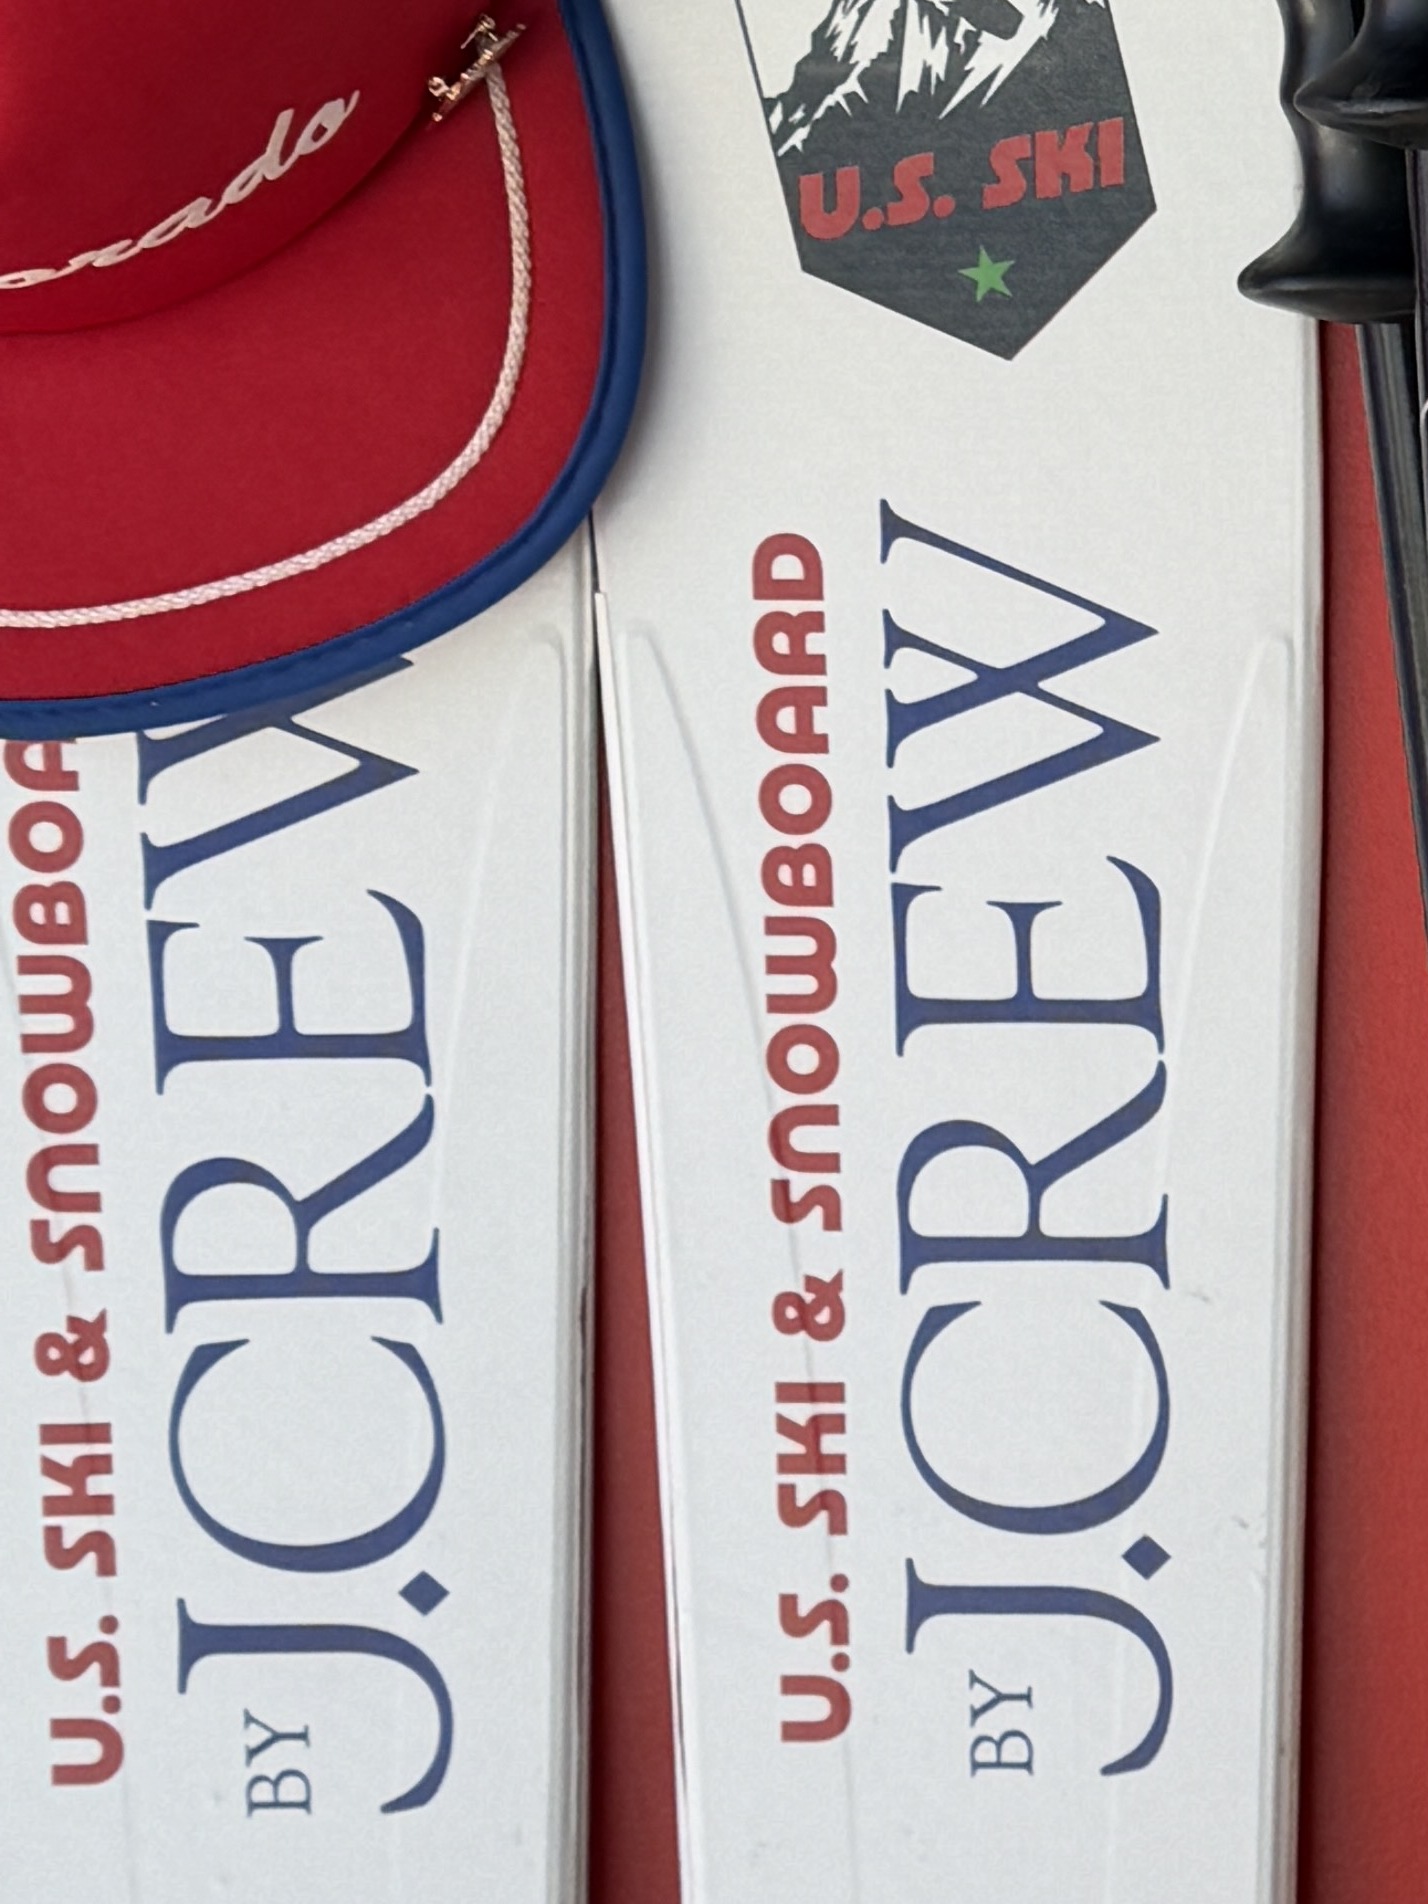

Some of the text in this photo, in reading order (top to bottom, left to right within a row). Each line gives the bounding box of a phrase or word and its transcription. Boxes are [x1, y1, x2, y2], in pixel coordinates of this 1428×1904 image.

[799, 117, 1124, 240] U.S. SKI
[2, 738, 124, 1785] U.S. SKI & SNOWBOA
[134, 656, 454, 1815] BY J.CREW
[751, 532, 852, 1743] U.S. SKI & SNOWBOARD
[880, 499, 1174, 1778] BY J.CREW
